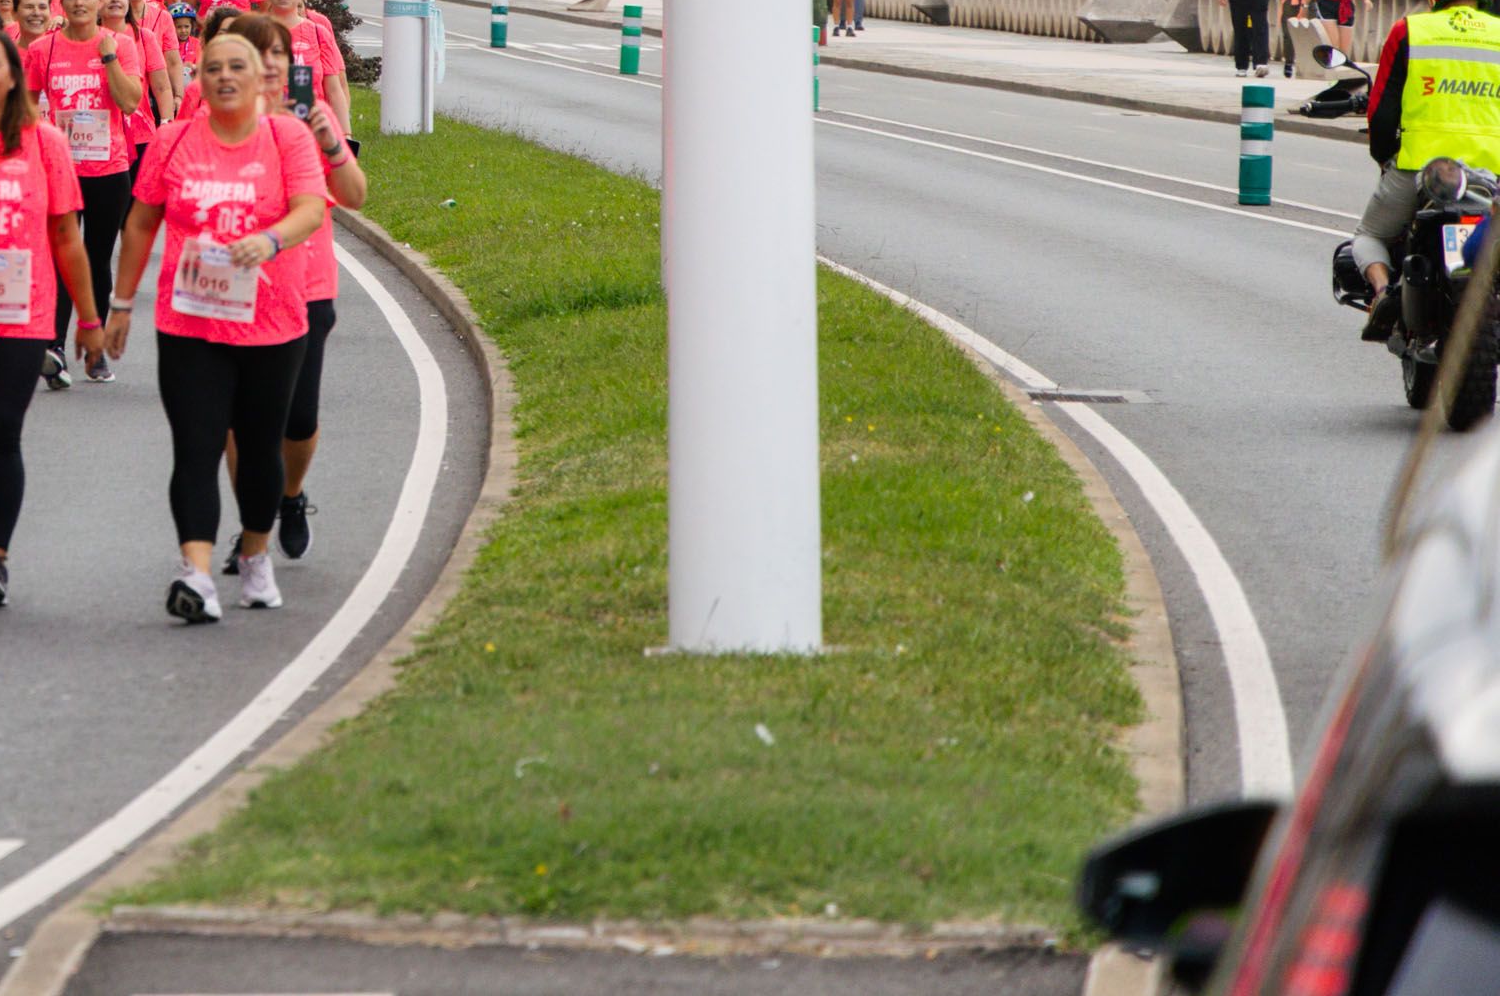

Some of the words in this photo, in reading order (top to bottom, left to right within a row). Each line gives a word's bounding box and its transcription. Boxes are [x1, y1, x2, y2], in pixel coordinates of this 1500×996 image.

[51, 73, 101, 90] CARRERA
[73, 132, 93, 141] 016
[179, 178, 256, 203] CARRERA
[199, 276, 229, 293] 016
